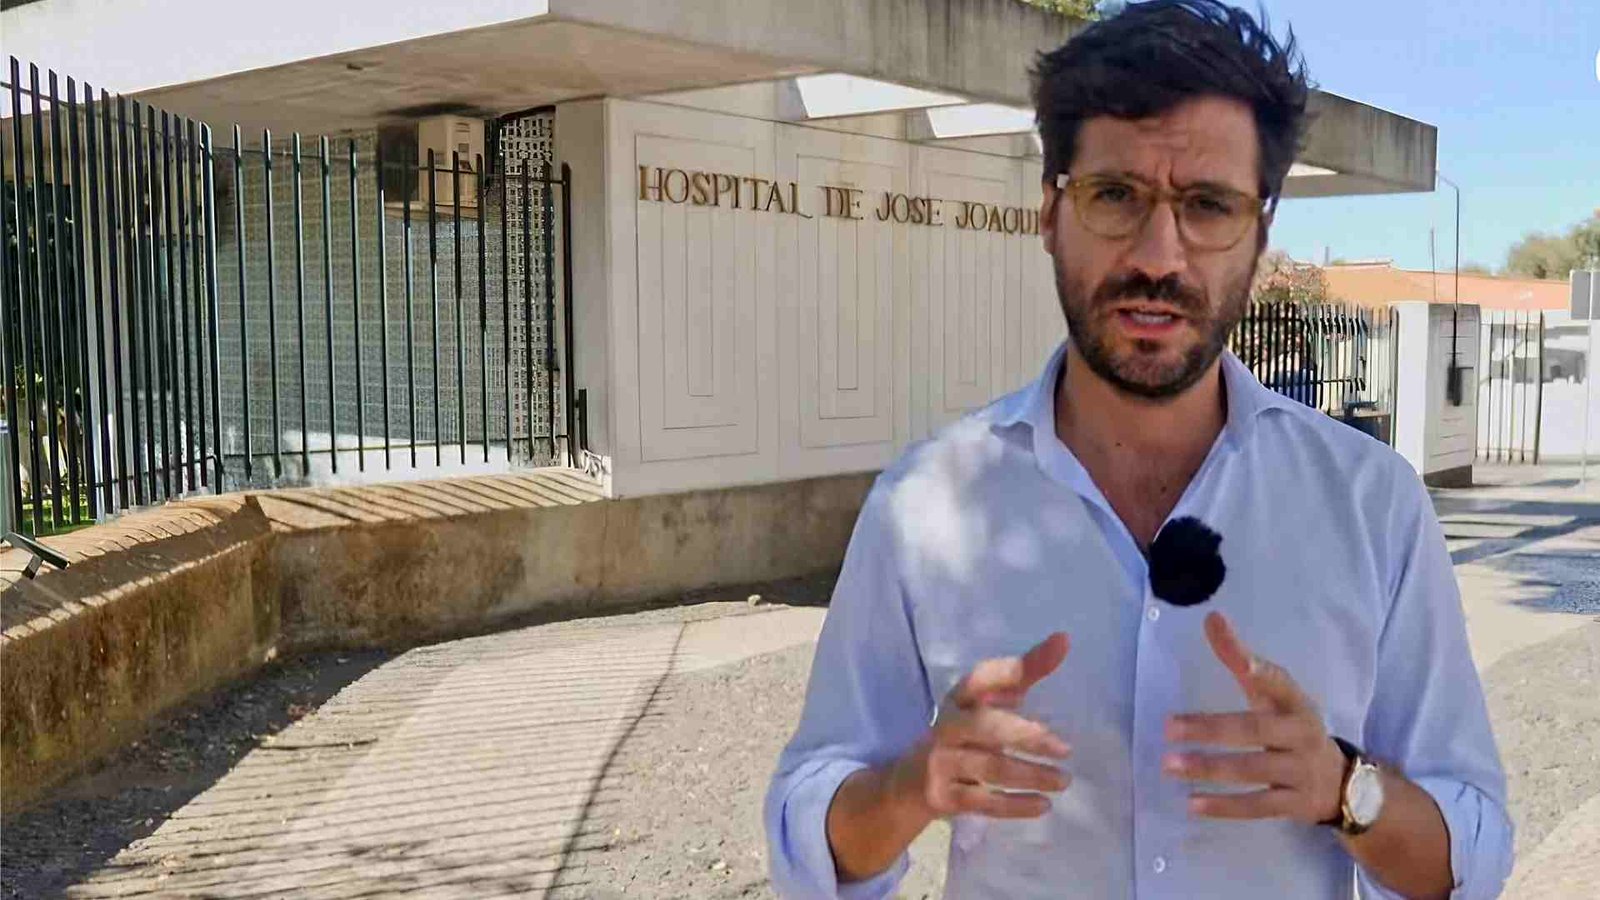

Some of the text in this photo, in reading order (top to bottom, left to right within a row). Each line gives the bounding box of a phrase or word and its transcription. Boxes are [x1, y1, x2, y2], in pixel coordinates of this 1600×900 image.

[638, 164, 813, 219] HOSPITAL
[817, 186, 864, 220] DE
[876, 192, 943, 226] JOSE
